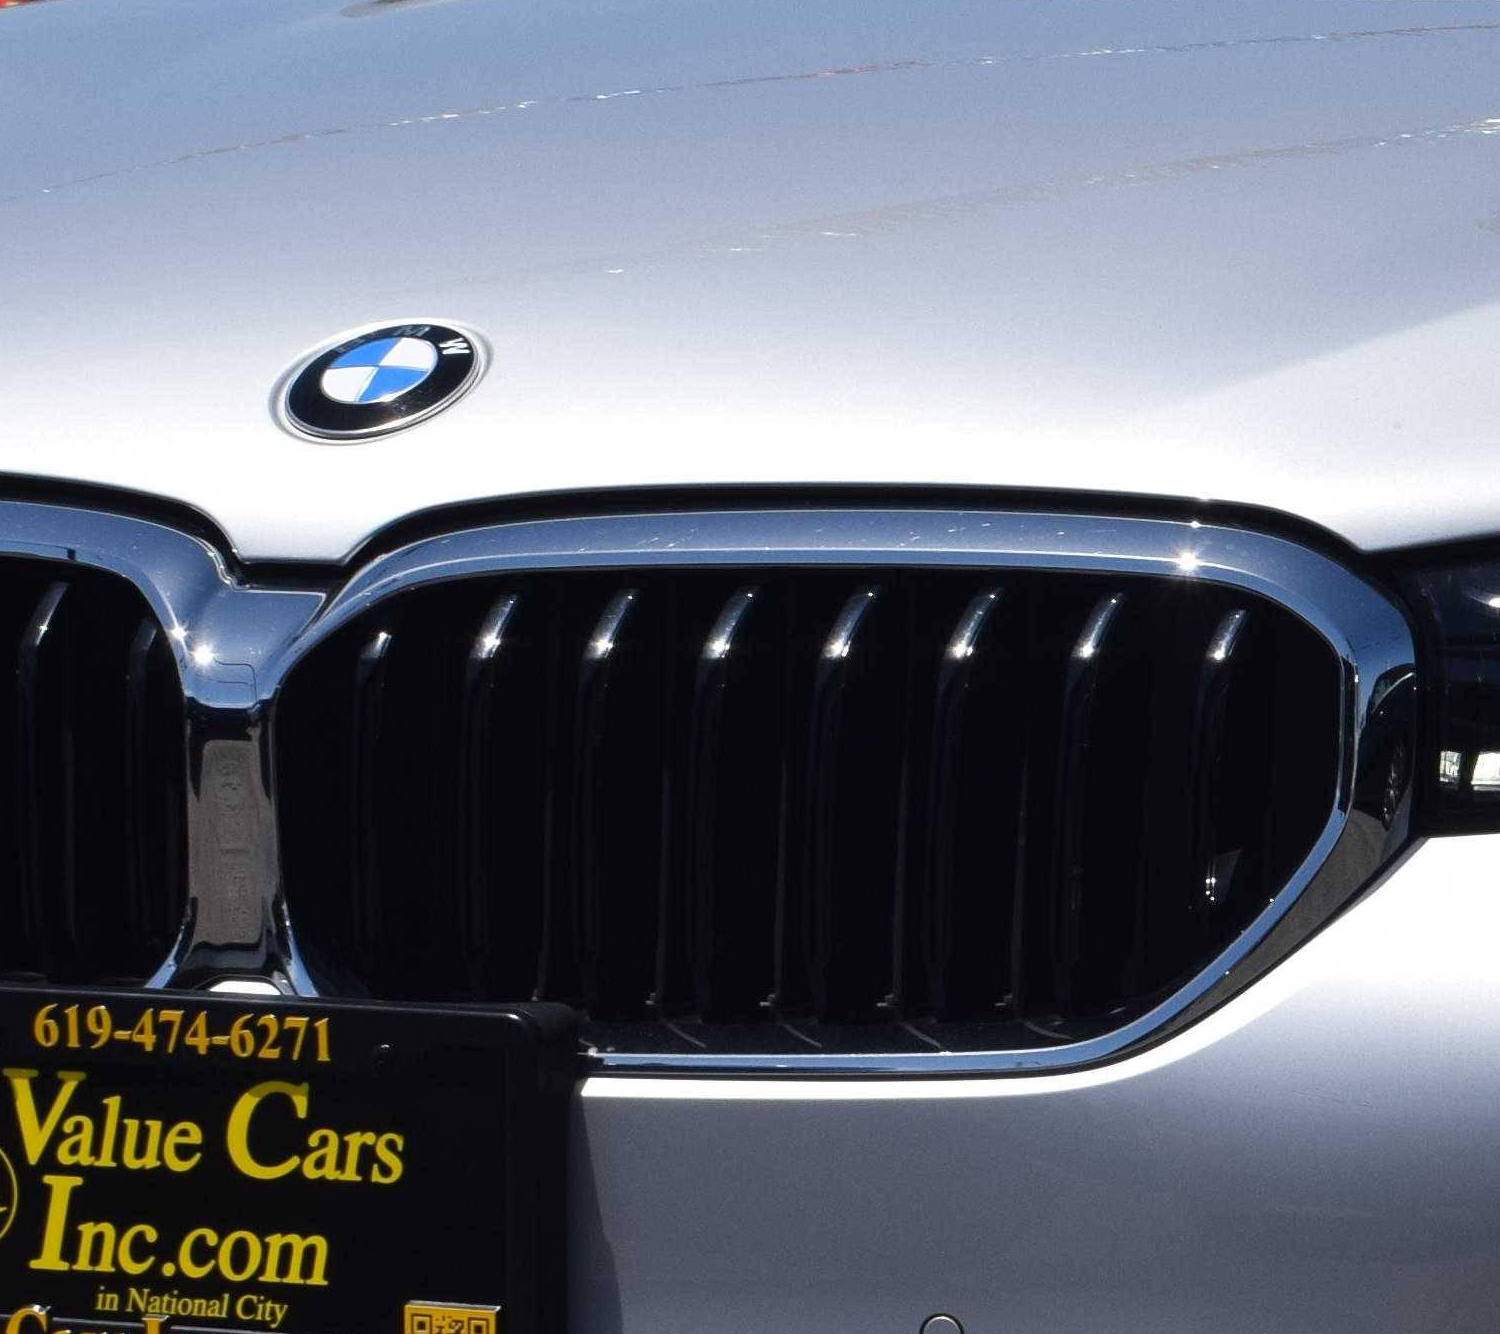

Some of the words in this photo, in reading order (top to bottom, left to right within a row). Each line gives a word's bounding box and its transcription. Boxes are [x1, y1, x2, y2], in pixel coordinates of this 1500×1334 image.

[33, 1003, 332, 1063] 619-474-6271
[3, 1067, 202, 1172] Value
[226, 1080, 406, 1185] Cars
[29, 1174, 330, 1287] Inc.com
[96, 1285, 119, 1311] in
[126, 1287, 228, 1318] National
[236, 1294, 288, 1329] City
